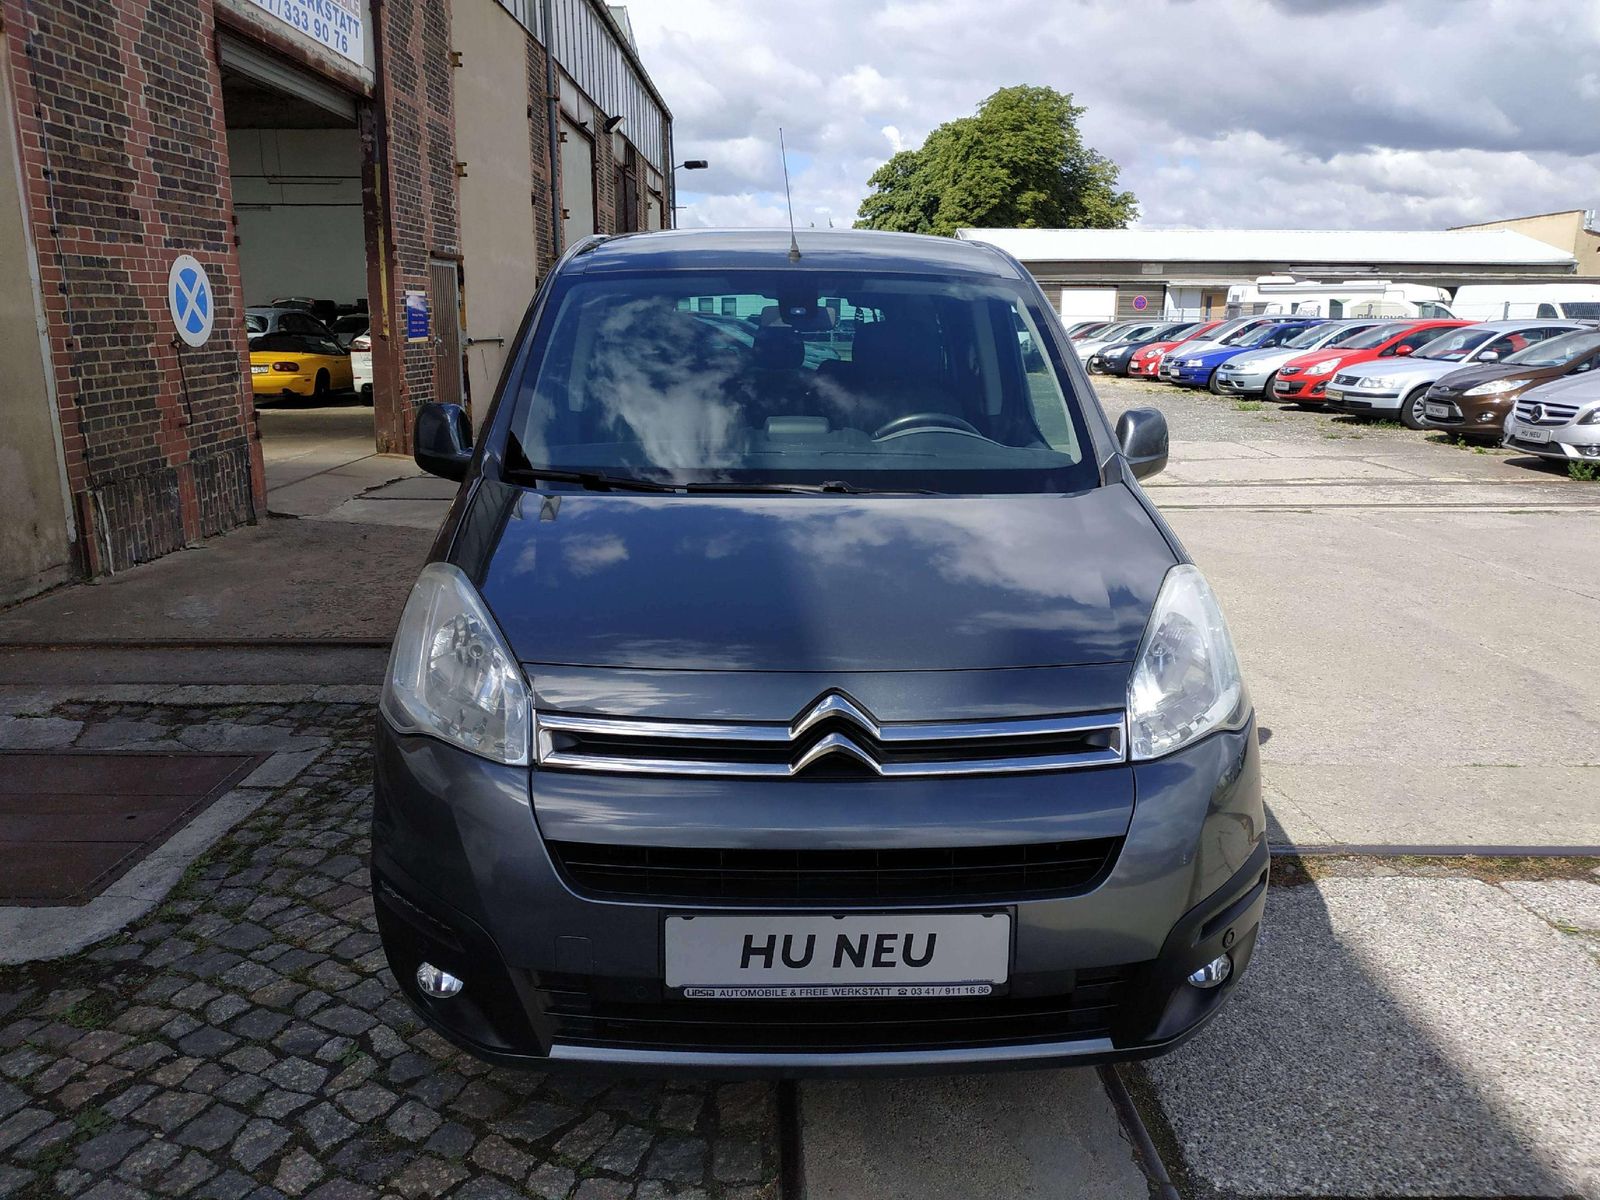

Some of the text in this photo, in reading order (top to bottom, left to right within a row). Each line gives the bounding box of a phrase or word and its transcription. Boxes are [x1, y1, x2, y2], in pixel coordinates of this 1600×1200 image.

[313, 18, 329, 42] 90
[334, 29, 348, 53] 76
[740, 933, 937, 969] HU NEU
[719, 987, 787, 998] AUTOMOBILE
[789, 988, 797, 997] &
[799, 987, 829, 997] FREIE
[831, 986, 892, 997] WERKSTATT
[910, 986, 922, 996] 03
[924, 986, 935, 995] 41
[944, 986, 961, 995] 911
[965, 985, 976, 995] 16
